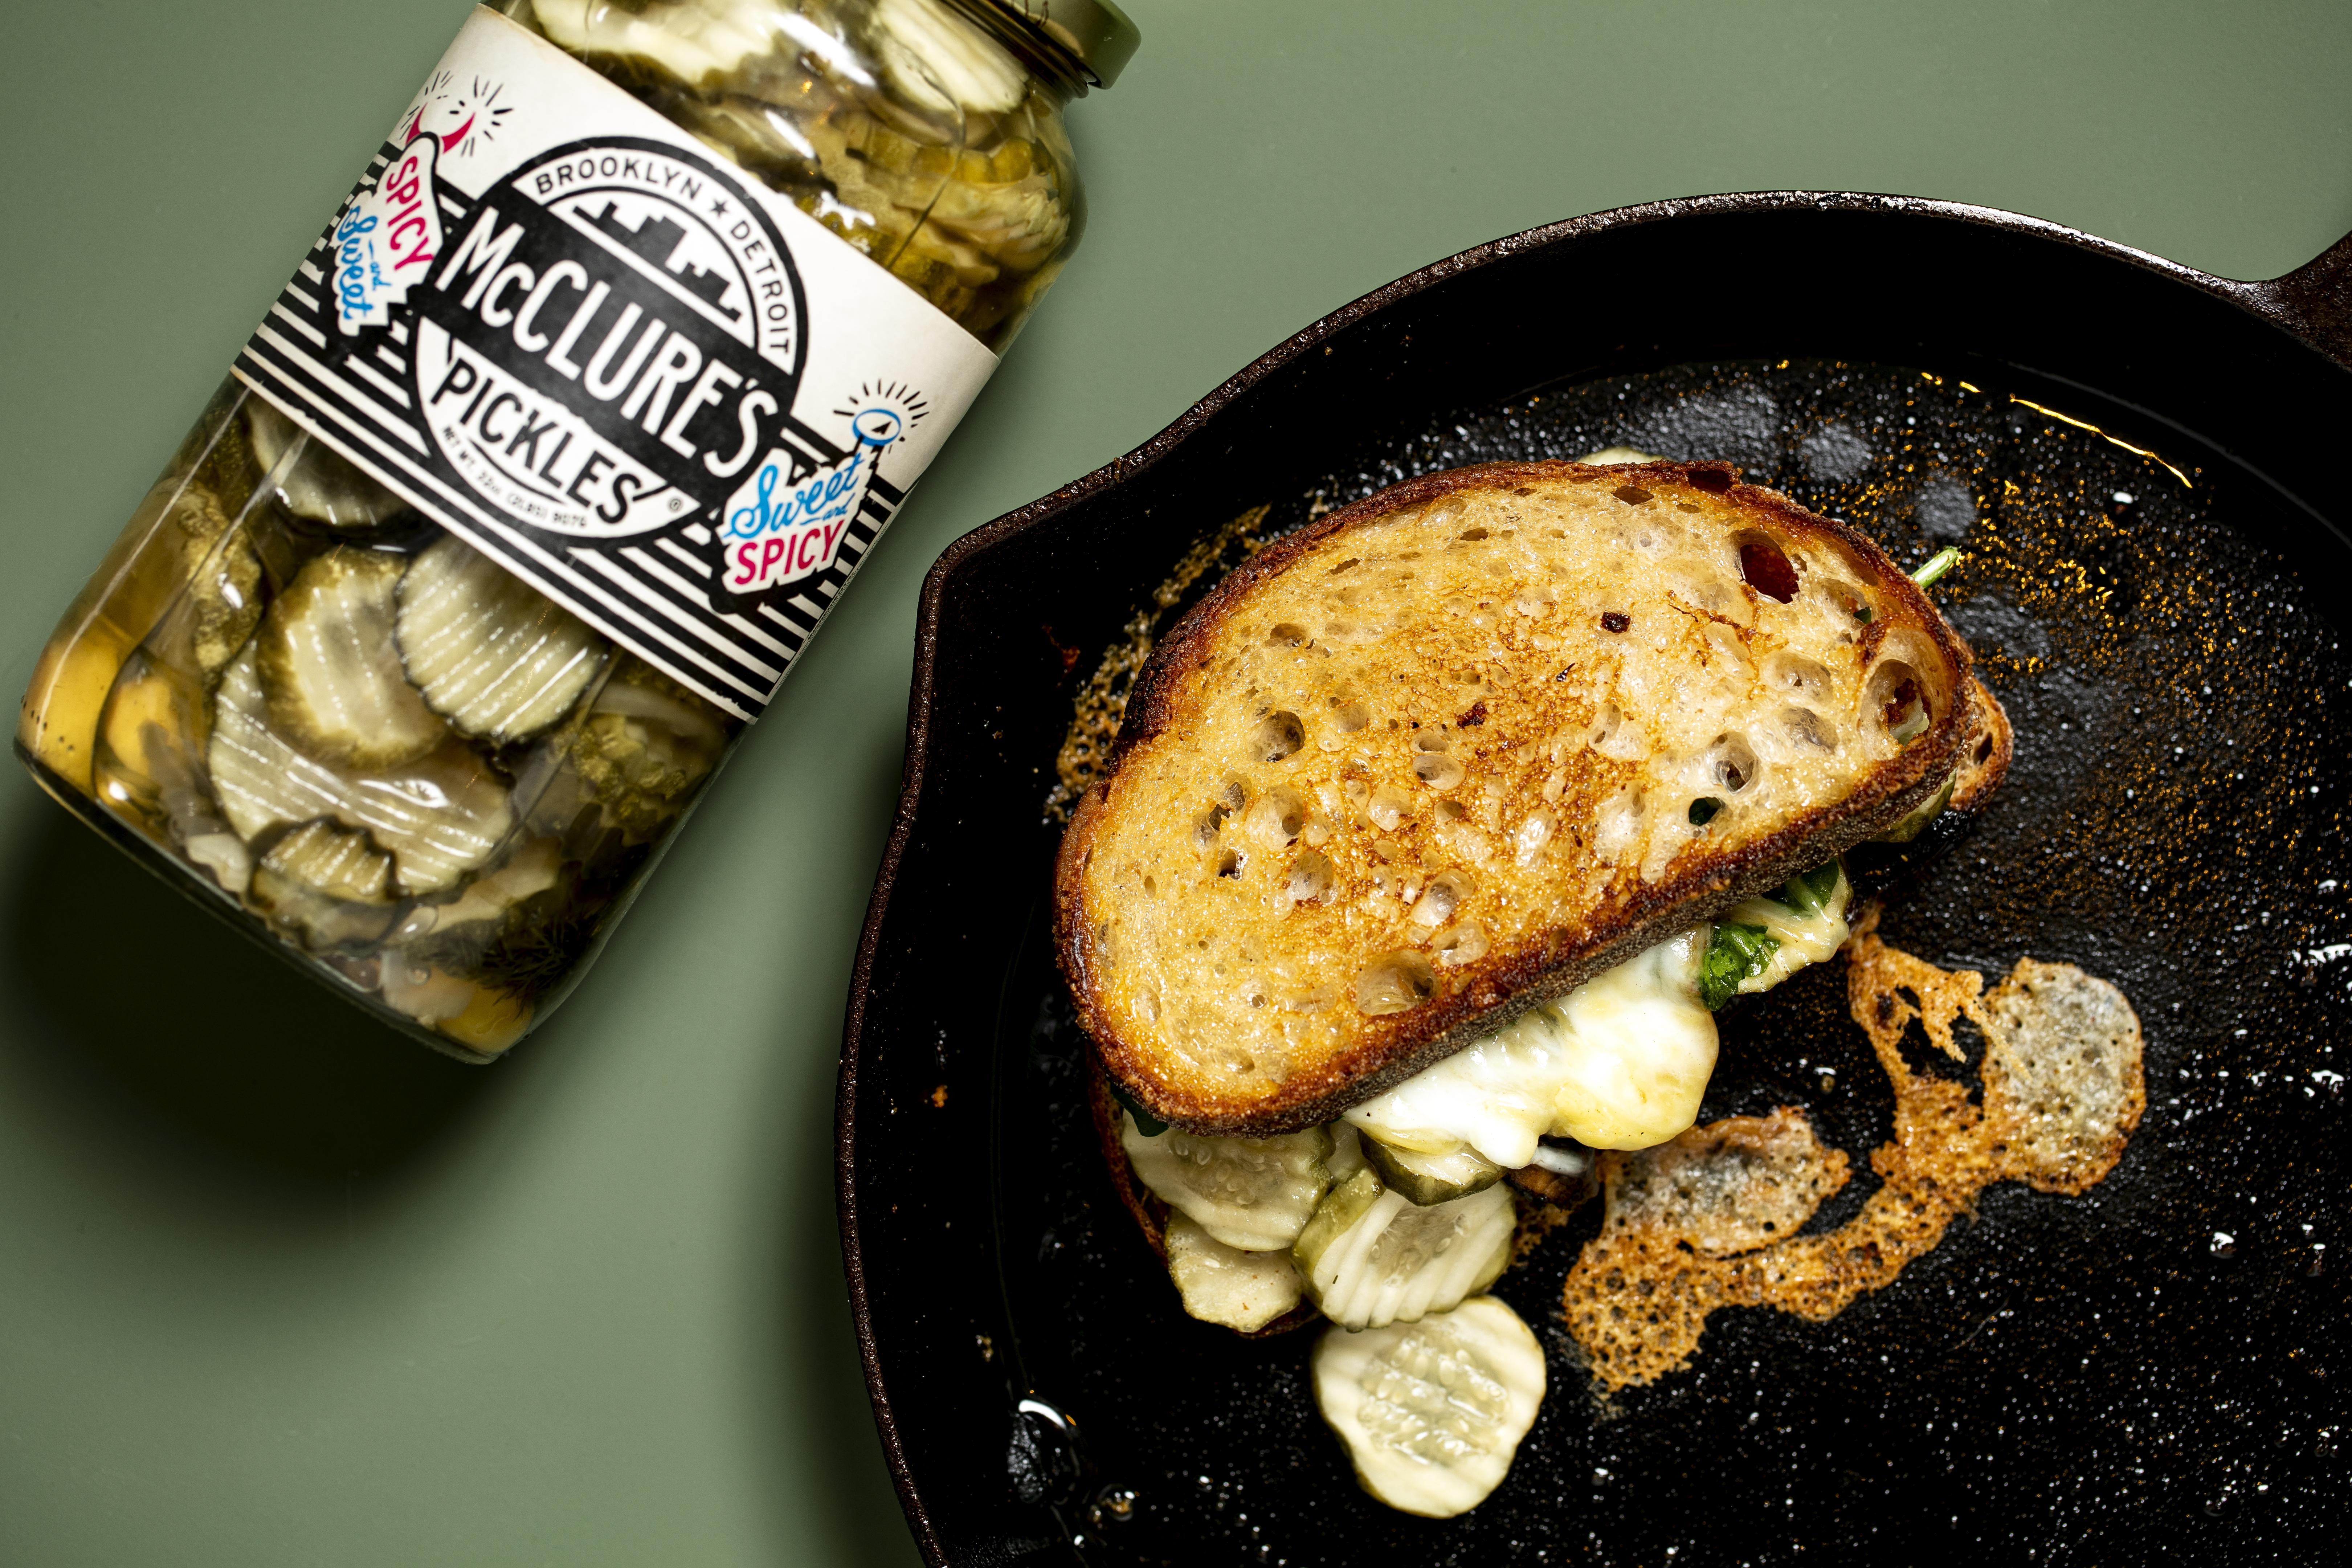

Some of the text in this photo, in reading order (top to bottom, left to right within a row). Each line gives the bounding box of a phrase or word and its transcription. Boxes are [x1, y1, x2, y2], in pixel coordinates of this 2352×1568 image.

[337, 205, 378, 319] Sweet
[387, 156, 434, 271] SPICY
[535, 157, 790, 353] BROOKLYN DETROIT
[370, 262, 392, 291] and
[435, 206, 779, 478] McCLURE'S
[430, 357, 642, 523] PICKLES
[443, 426, 461, 448] NET
[722, 453, 865, 539] Sweet
[822, 493, 856, 521] and
[734, 519, 845, 585] SPICY
